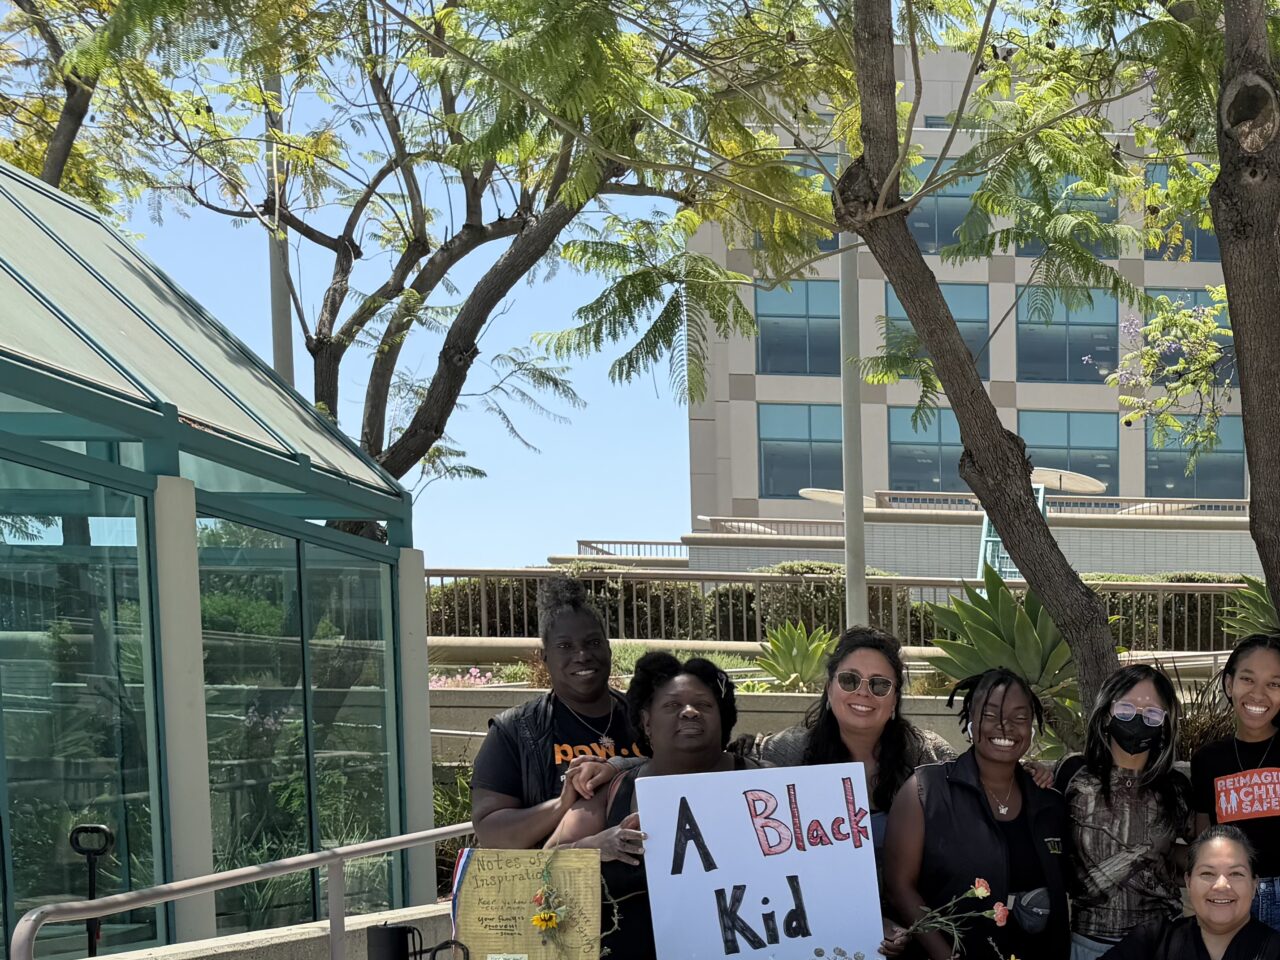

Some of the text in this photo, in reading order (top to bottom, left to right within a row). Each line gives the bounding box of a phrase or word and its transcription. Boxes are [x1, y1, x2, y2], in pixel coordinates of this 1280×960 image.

[670, 776, 870, 875] A Black
[472, 868, 544, 893] Inspiratio
[476, 852, 544, 872] Notes of
[714, 874, 812, 956] Kid
